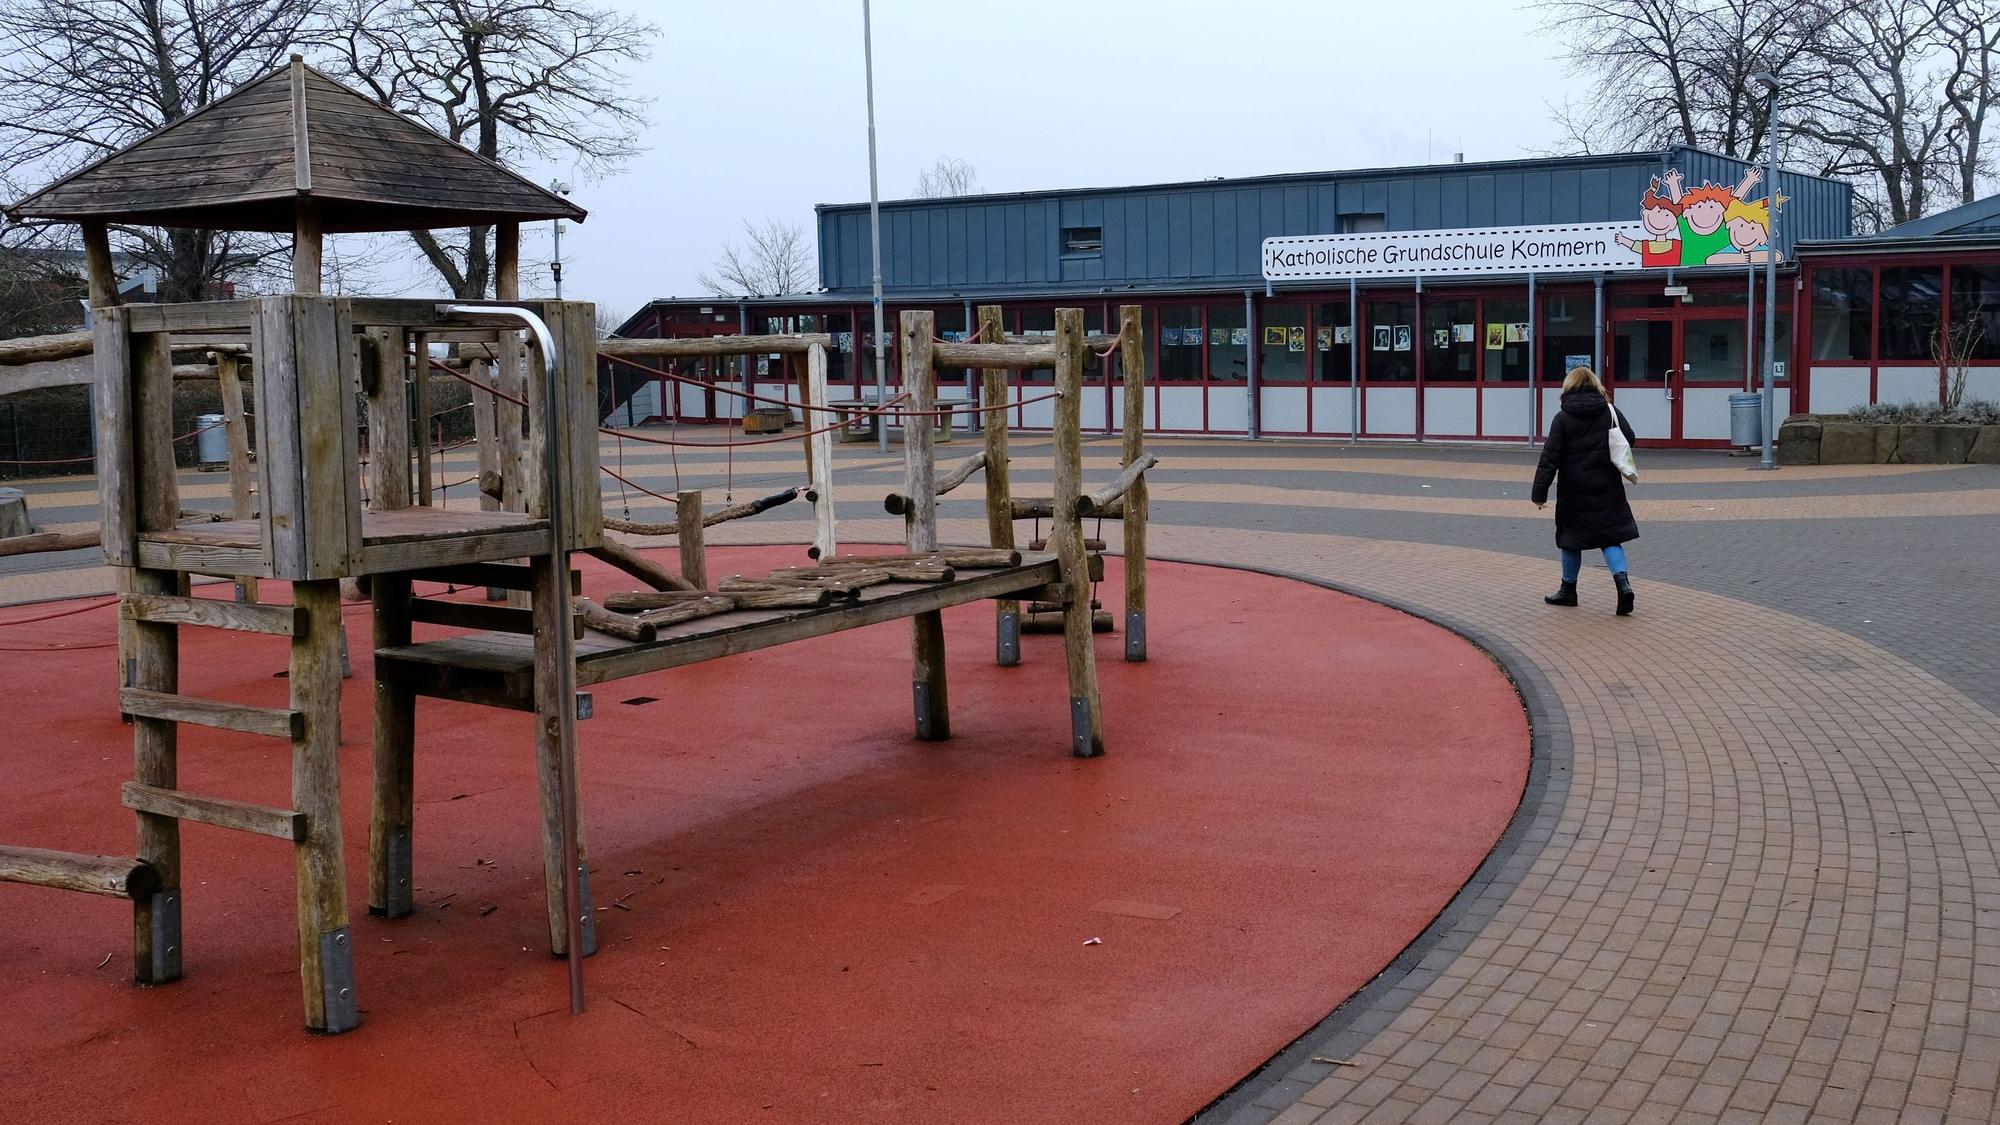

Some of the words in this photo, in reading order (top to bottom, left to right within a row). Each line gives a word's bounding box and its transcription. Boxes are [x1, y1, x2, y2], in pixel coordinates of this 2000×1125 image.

[1271, 247, 1379, 269] Katholische
[1383, 242, 1505, 264] Grundschule
[1511, 239, 1606, 261] Kommern
